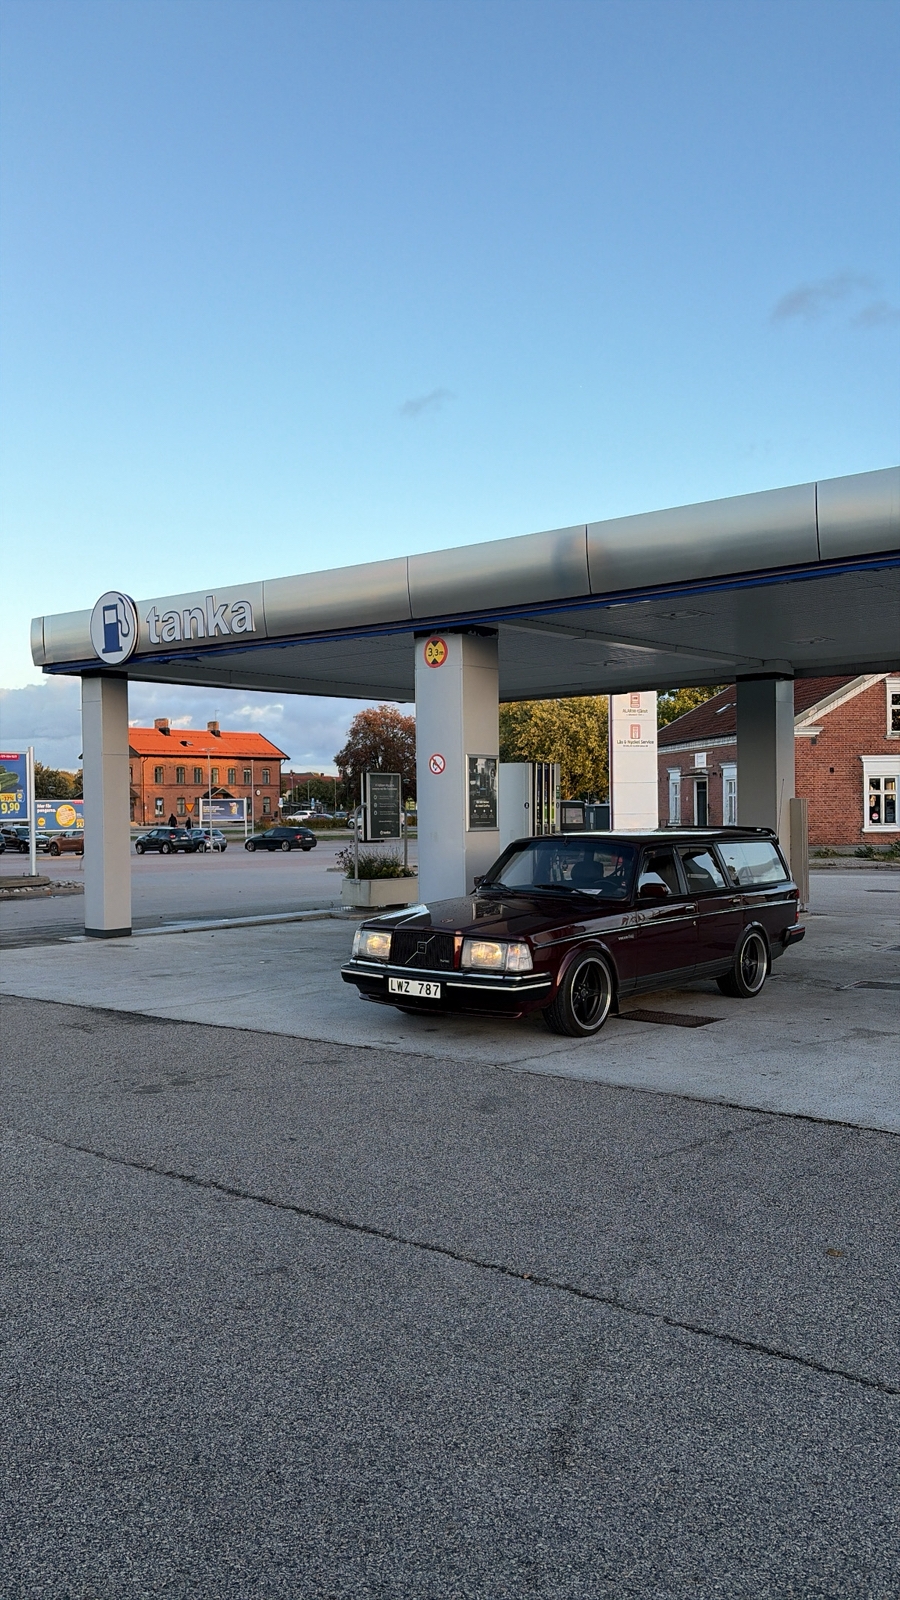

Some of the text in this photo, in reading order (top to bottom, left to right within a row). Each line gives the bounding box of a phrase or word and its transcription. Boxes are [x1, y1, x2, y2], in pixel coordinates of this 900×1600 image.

[146, 595, 256, 644] tanka
[390, 979, 440, 996] LWZ 787
